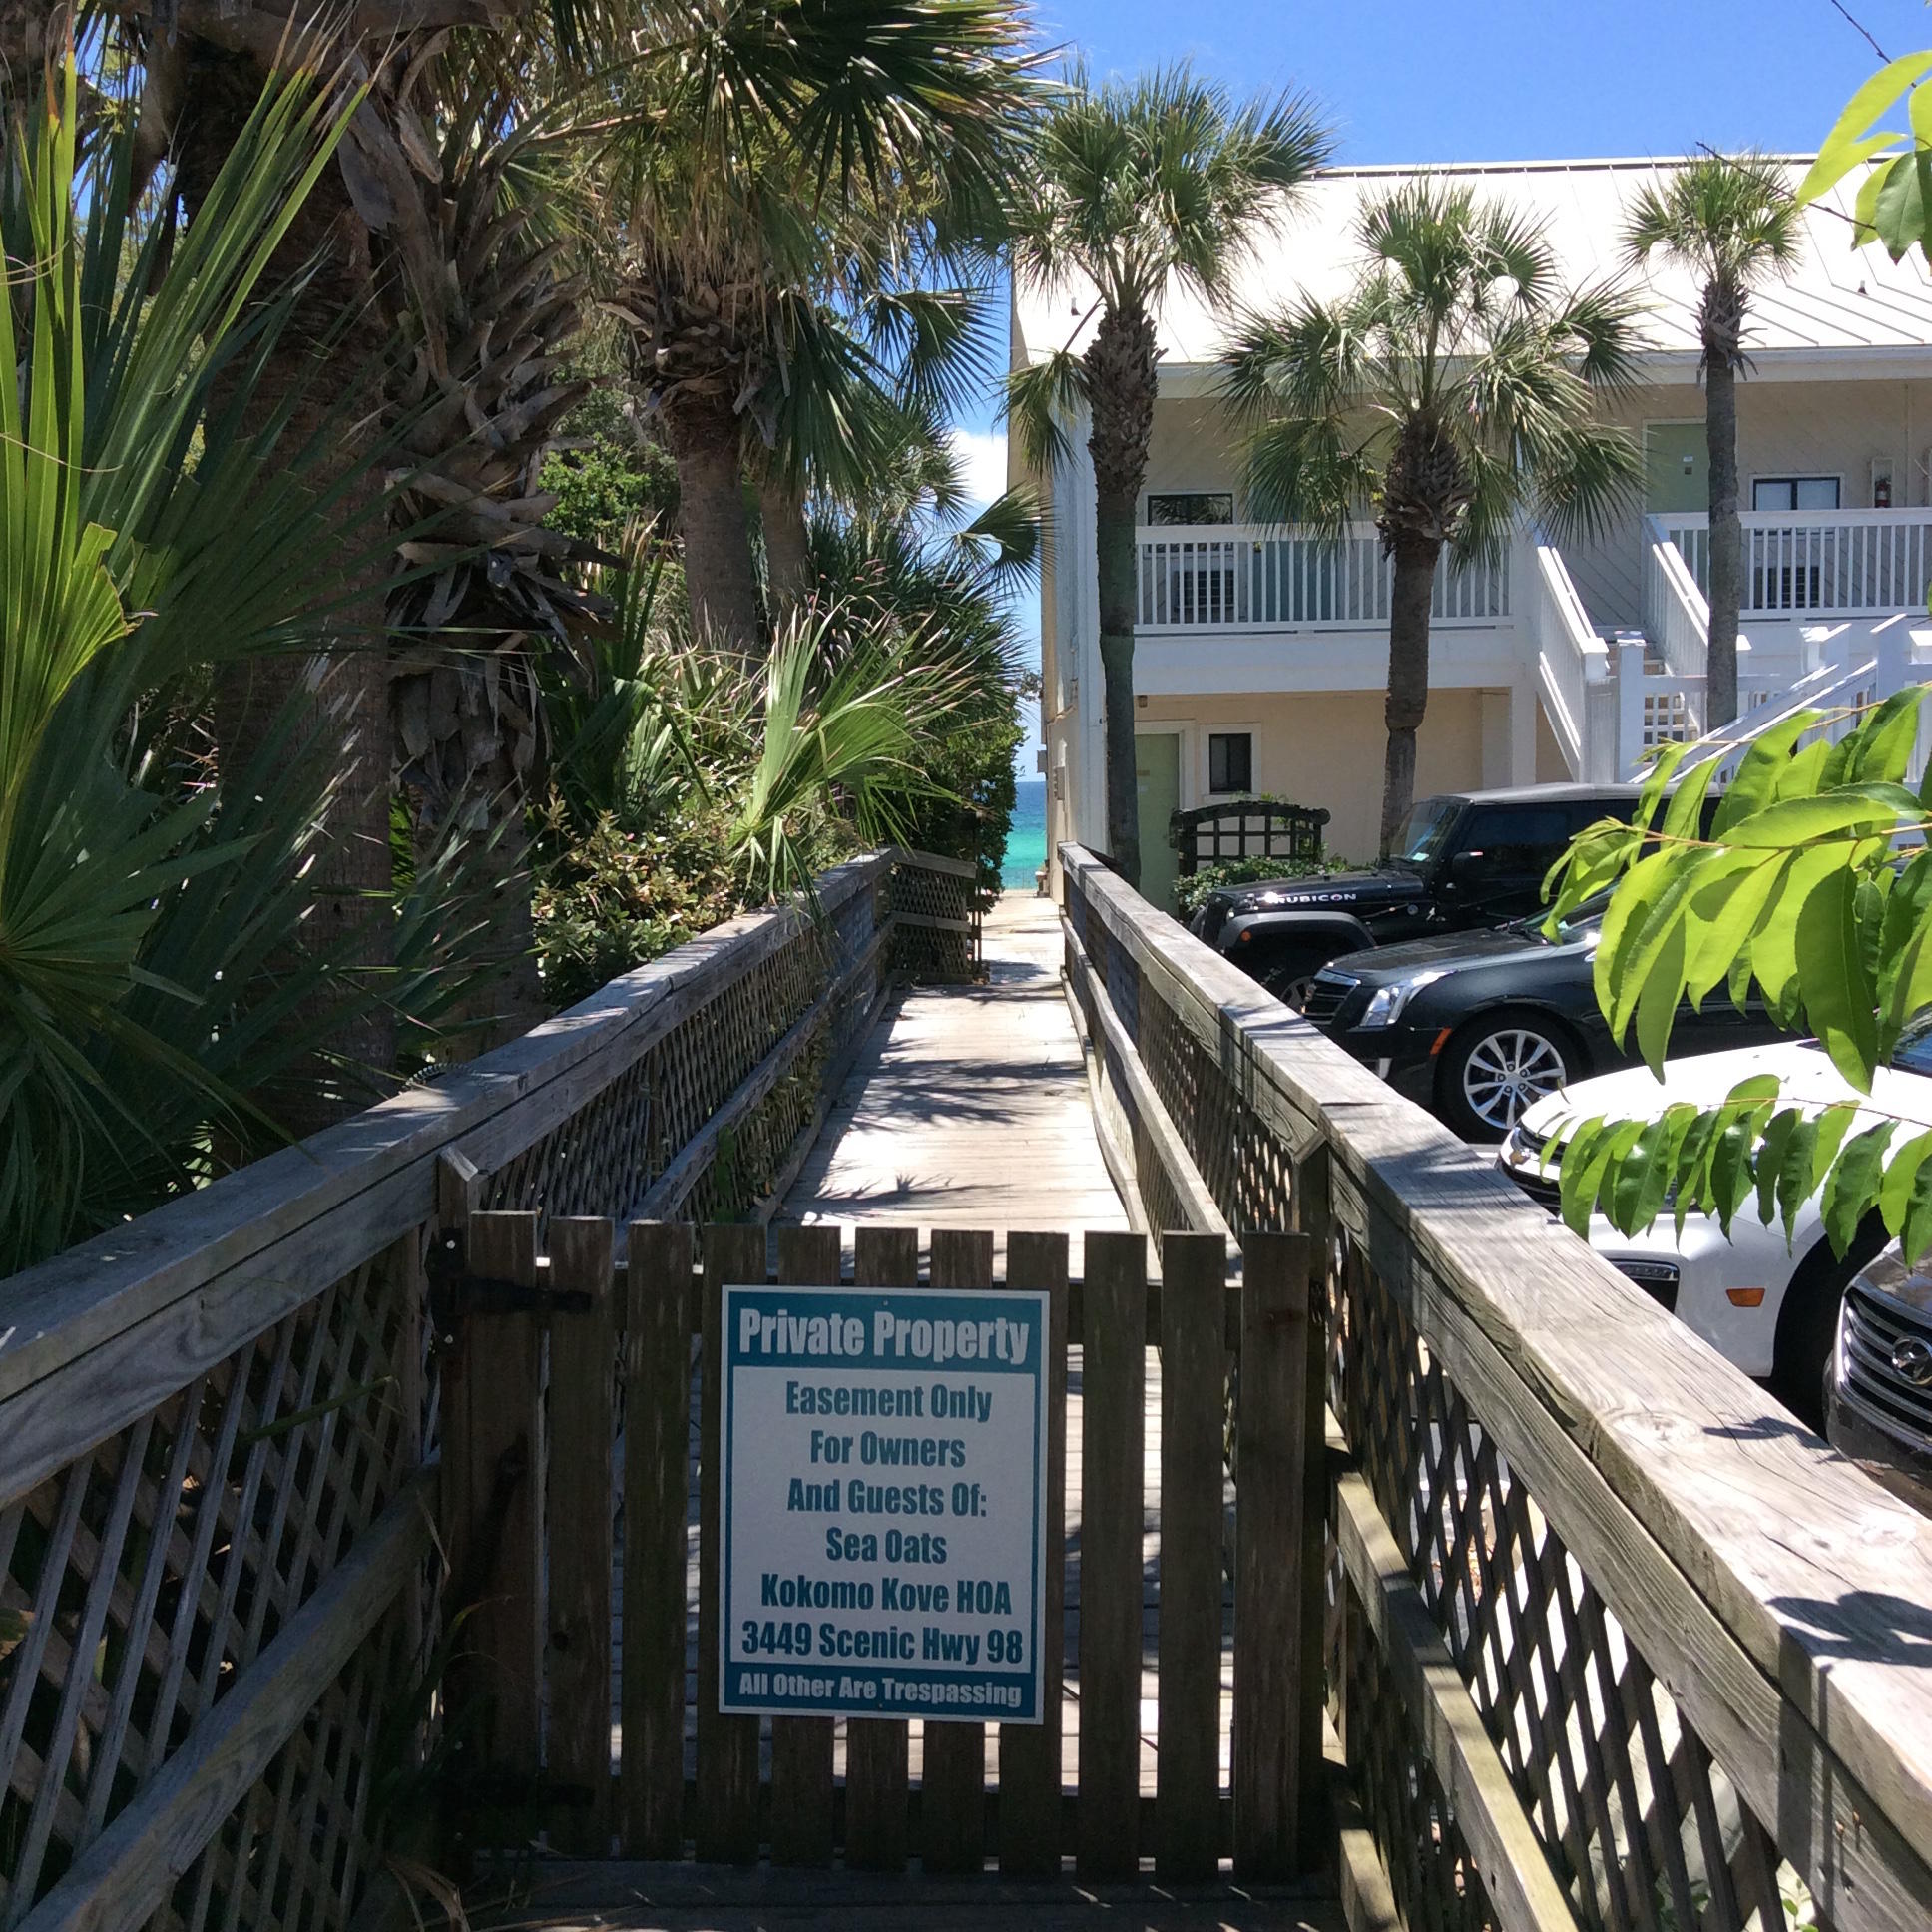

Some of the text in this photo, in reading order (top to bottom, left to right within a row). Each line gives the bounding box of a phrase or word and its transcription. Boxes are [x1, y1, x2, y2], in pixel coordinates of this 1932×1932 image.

[1275, 893, 1357, 904] RUBICON
[739, 1308, 1029, 1364] Private Property
[786, 1381, 992, 1423] Easement Only
[810, 1430, 966, 1468] For Owners
[787, 1479, 987, 1517] And Guests Of:
[826, 1527, 947, 1564] Sea Oats
[761, 1573, 1012, 1615] Kokomo Kove HOA
[742, 1621, 1023, 1665] 3449 Scenic Hwy 98
[739, 1673, 1022, 1707] All Other Are Trespassing
